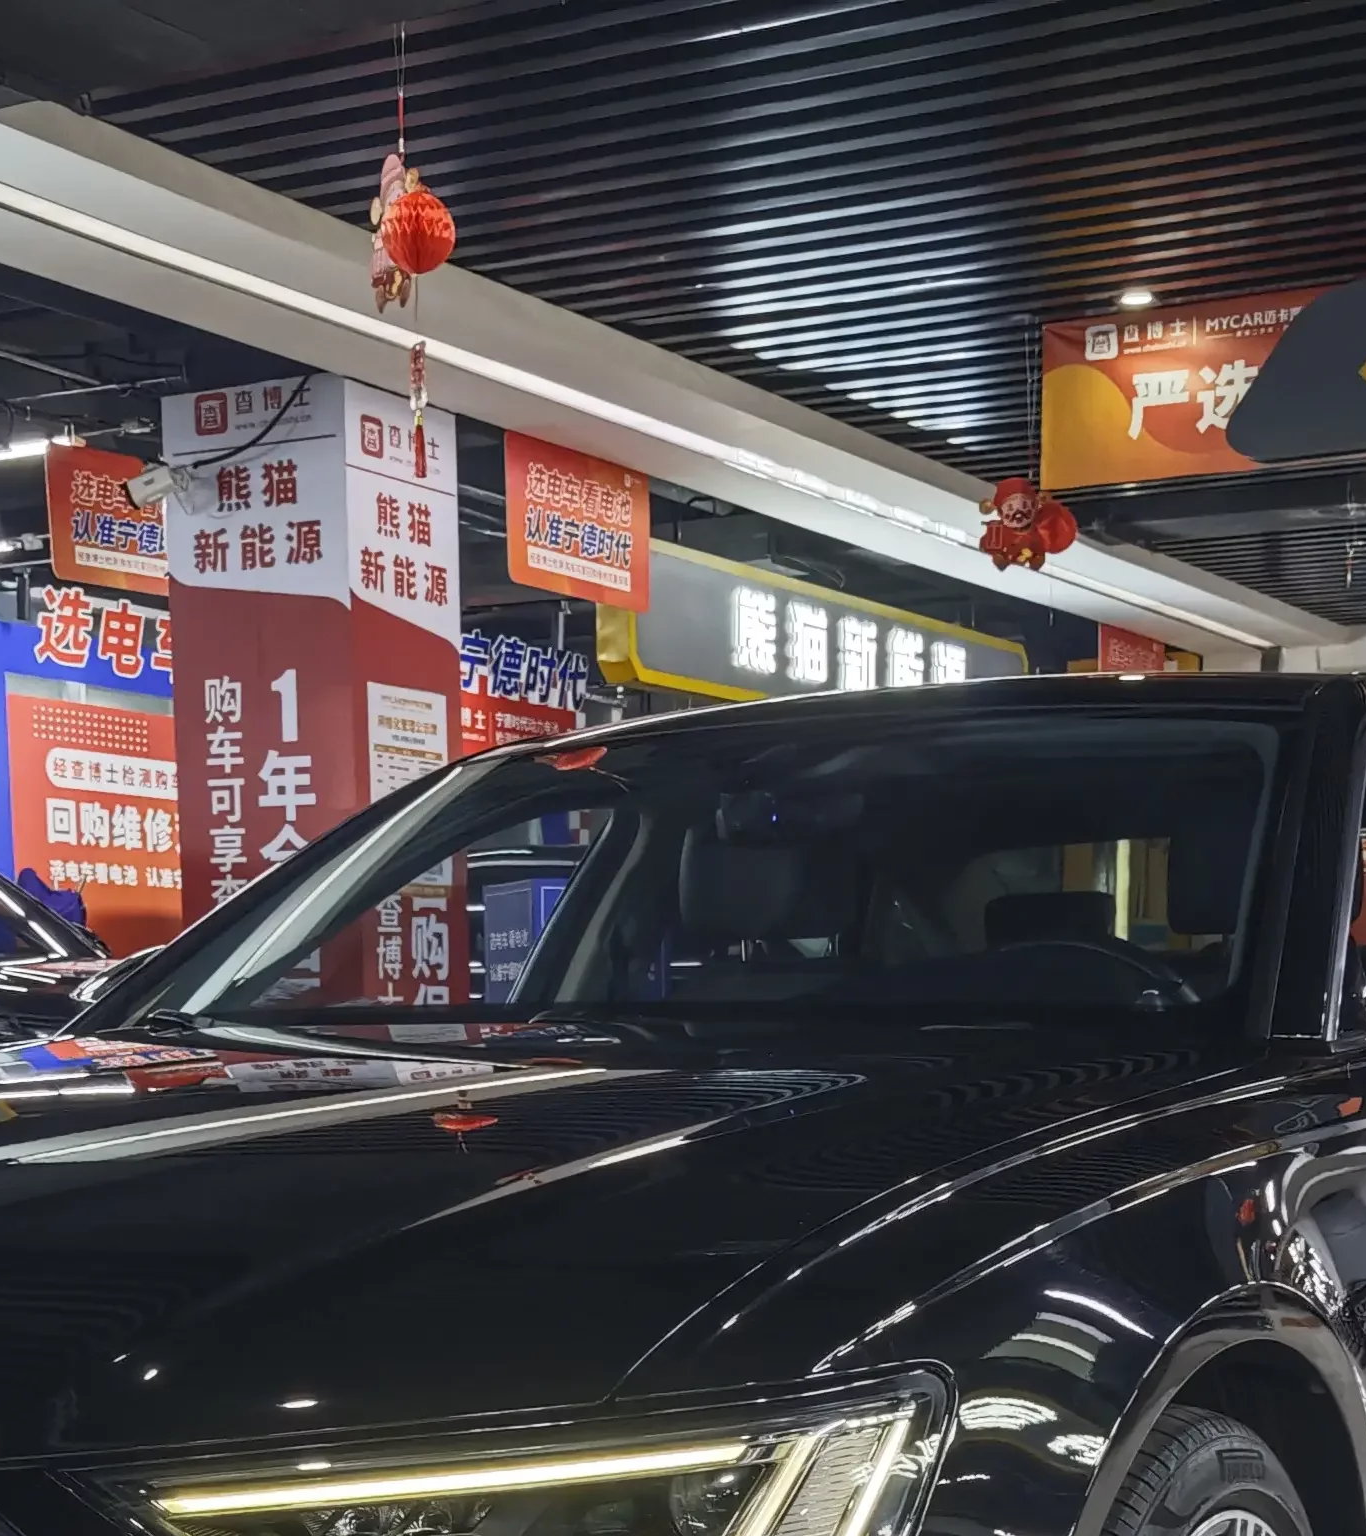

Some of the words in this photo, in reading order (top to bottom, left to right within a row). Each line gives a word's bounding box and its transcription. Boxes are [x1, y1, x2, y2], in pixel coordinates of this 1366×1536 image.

[1127, 358, 1260, 441] 严选
[216, 459, 299, 512] 熊猫
[524, 462, 633, 527] 选电车看电池
[71, 510, 167, 554] 认准宁德
[193, 519, 324, 575] 新能源
[375, 492, 432, 548] 熊猫
[524, 505, 633, 569] 认准宁德时代
[359, 546, 449, 607] 新能源
[731, 584, 967, 691] 熊猫新能源
[460, 629, 589, 713] 宁德时代
[45, 797, 181, 856] 回购维修
